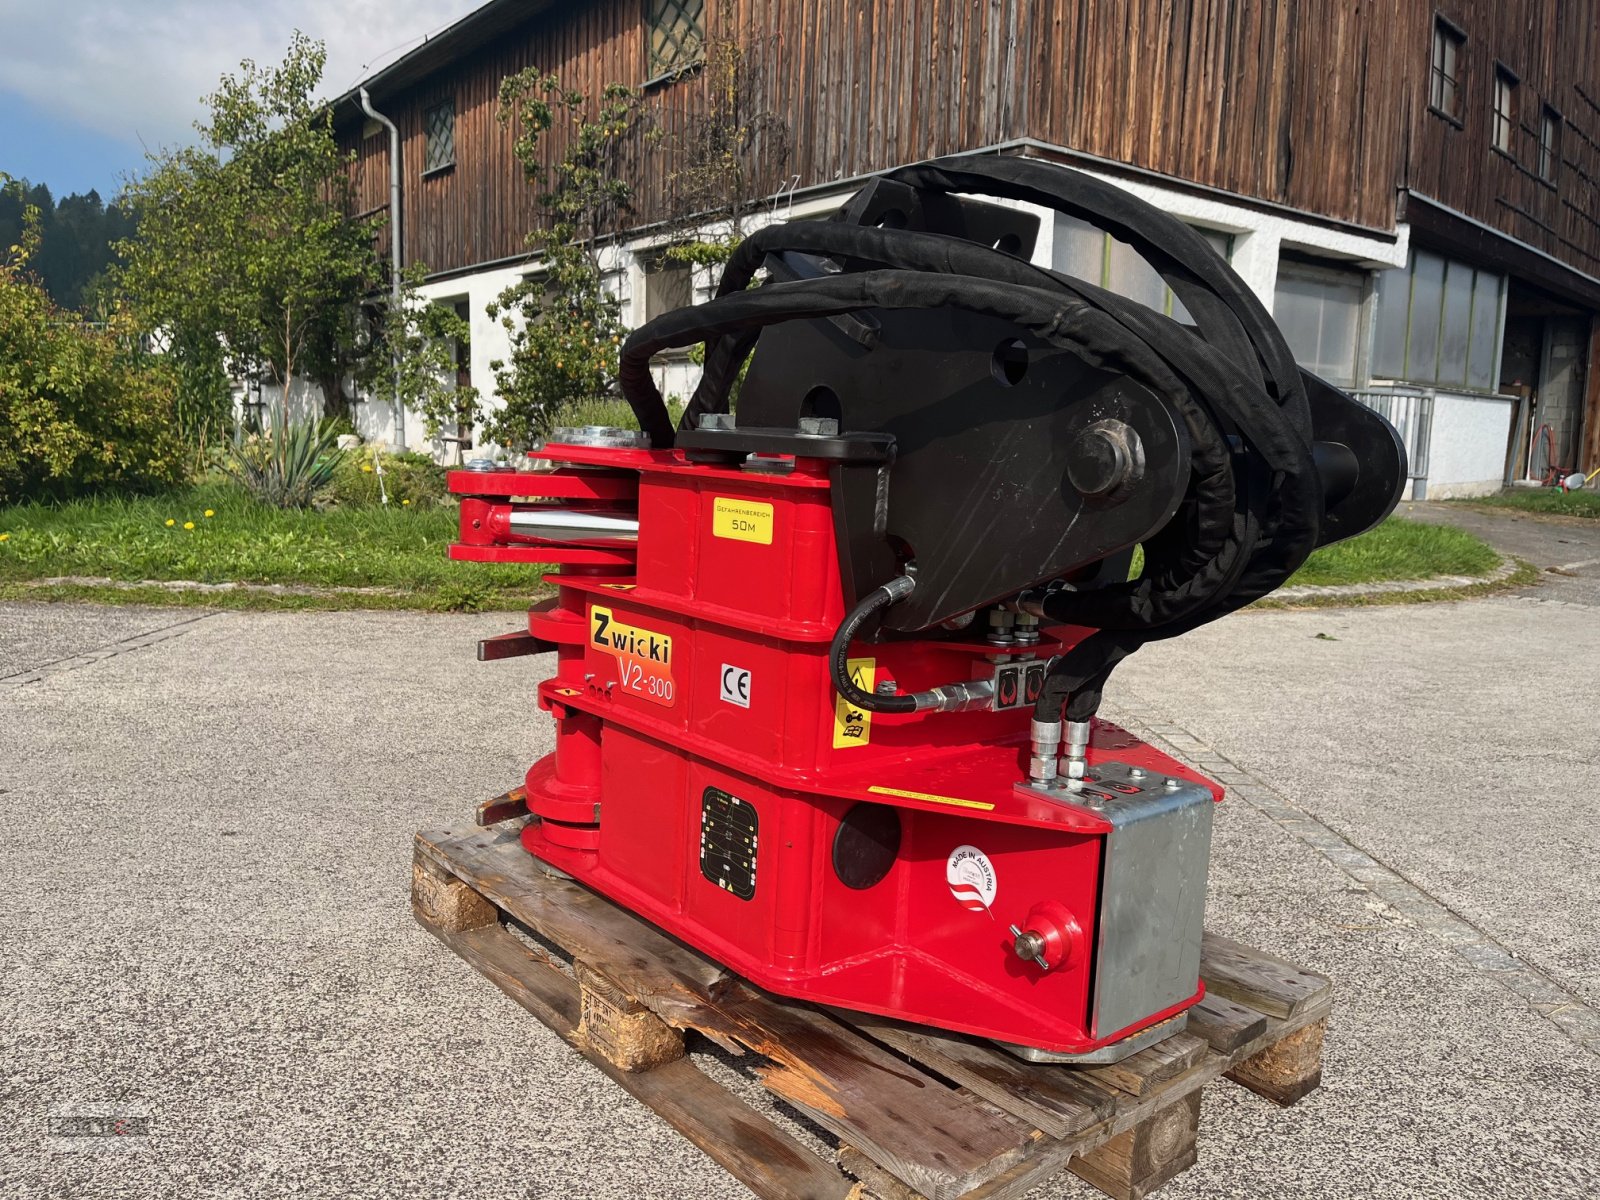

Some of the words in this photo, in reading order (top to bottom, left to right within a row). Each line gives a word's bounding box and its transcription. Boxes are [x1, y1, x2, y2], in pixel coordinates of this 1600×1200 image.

[717, 505, 771, 518] GEFAHRENBEREICH
[594, 612, 668, 664] Zwicki
[620, 656, 673, 700] V2-300
[723, 667, 749, 701] CE
[952, 852, 967, 868] MADE
[977, 858, 992, 891] AUSTRIA
